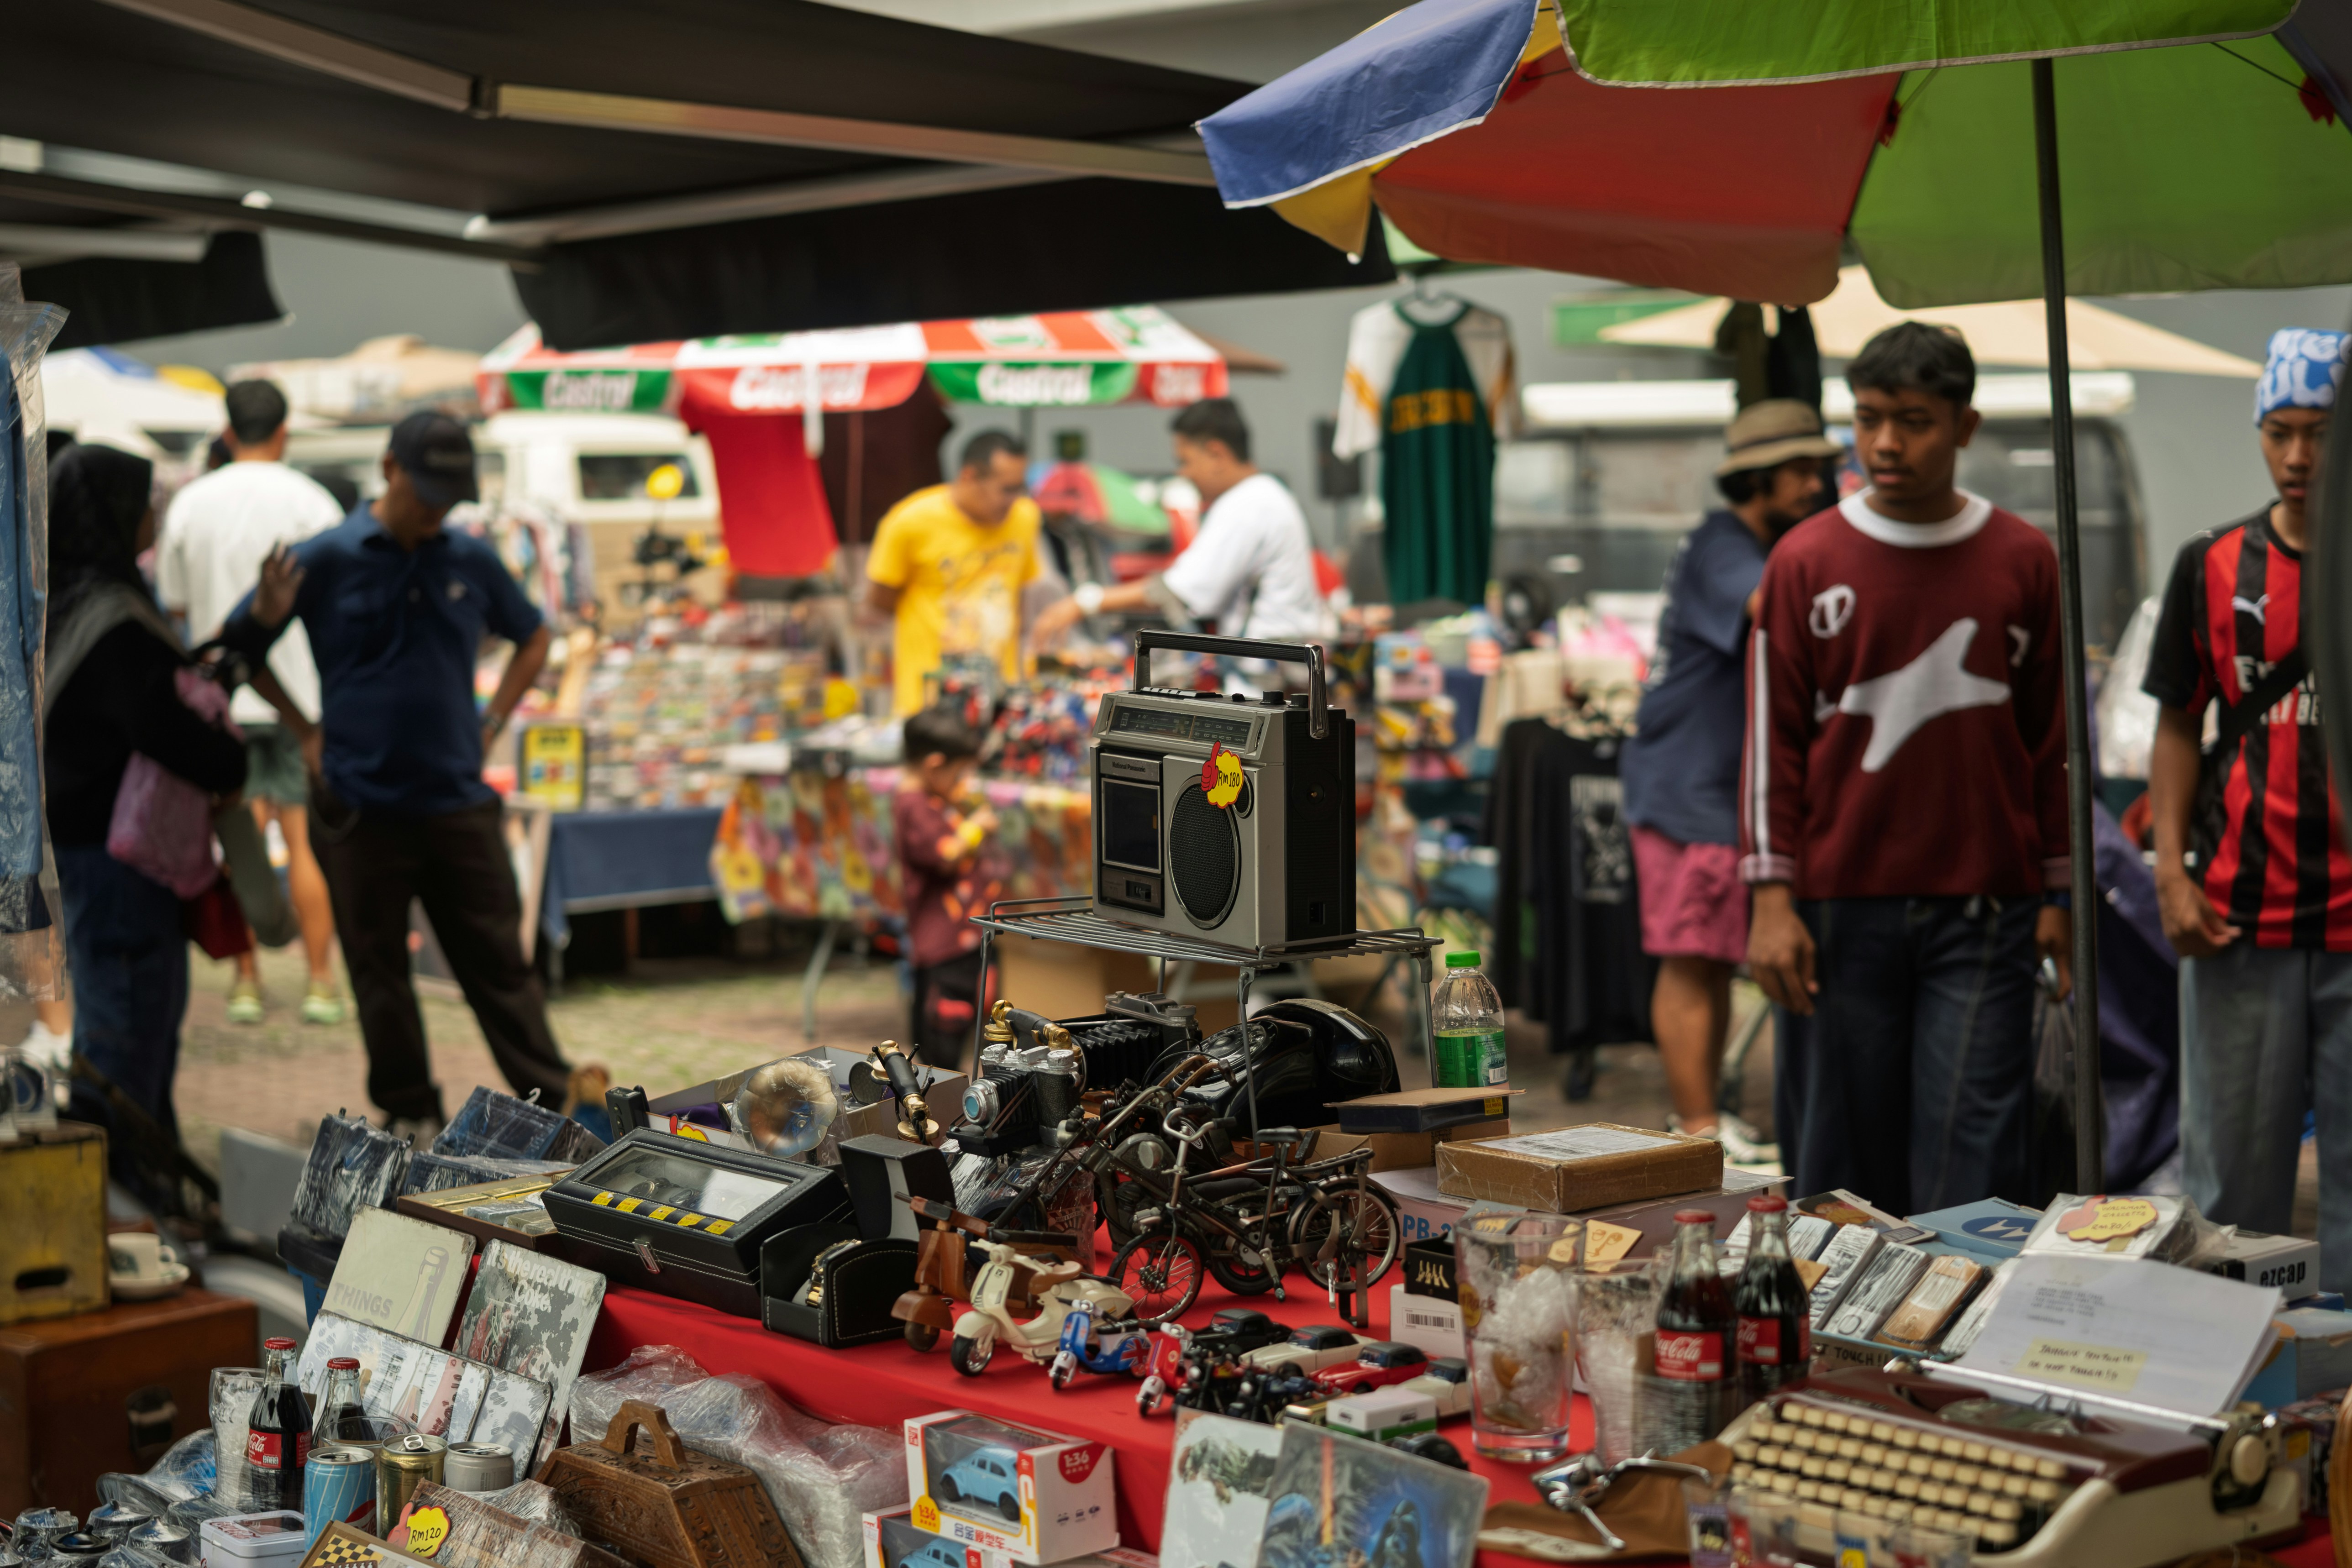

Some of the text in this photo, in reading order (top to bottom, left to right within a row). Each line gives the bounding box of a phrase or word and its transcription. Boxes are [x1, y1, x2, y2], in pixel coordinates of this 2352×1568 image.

[542, 370, 638, 409] Castrol
[730, 363, 870, 409] Casrol
[977, 363, 1095, 405] Castrol
[1112, 761, 1146, 772] National Panasonic
[507, 1250, 531, 1277] the
[530, 1263, 562, 1288] real
[2260, 1261, 2306, 1287] ezcap
[333, 1282, 394, 1320] THINGS
